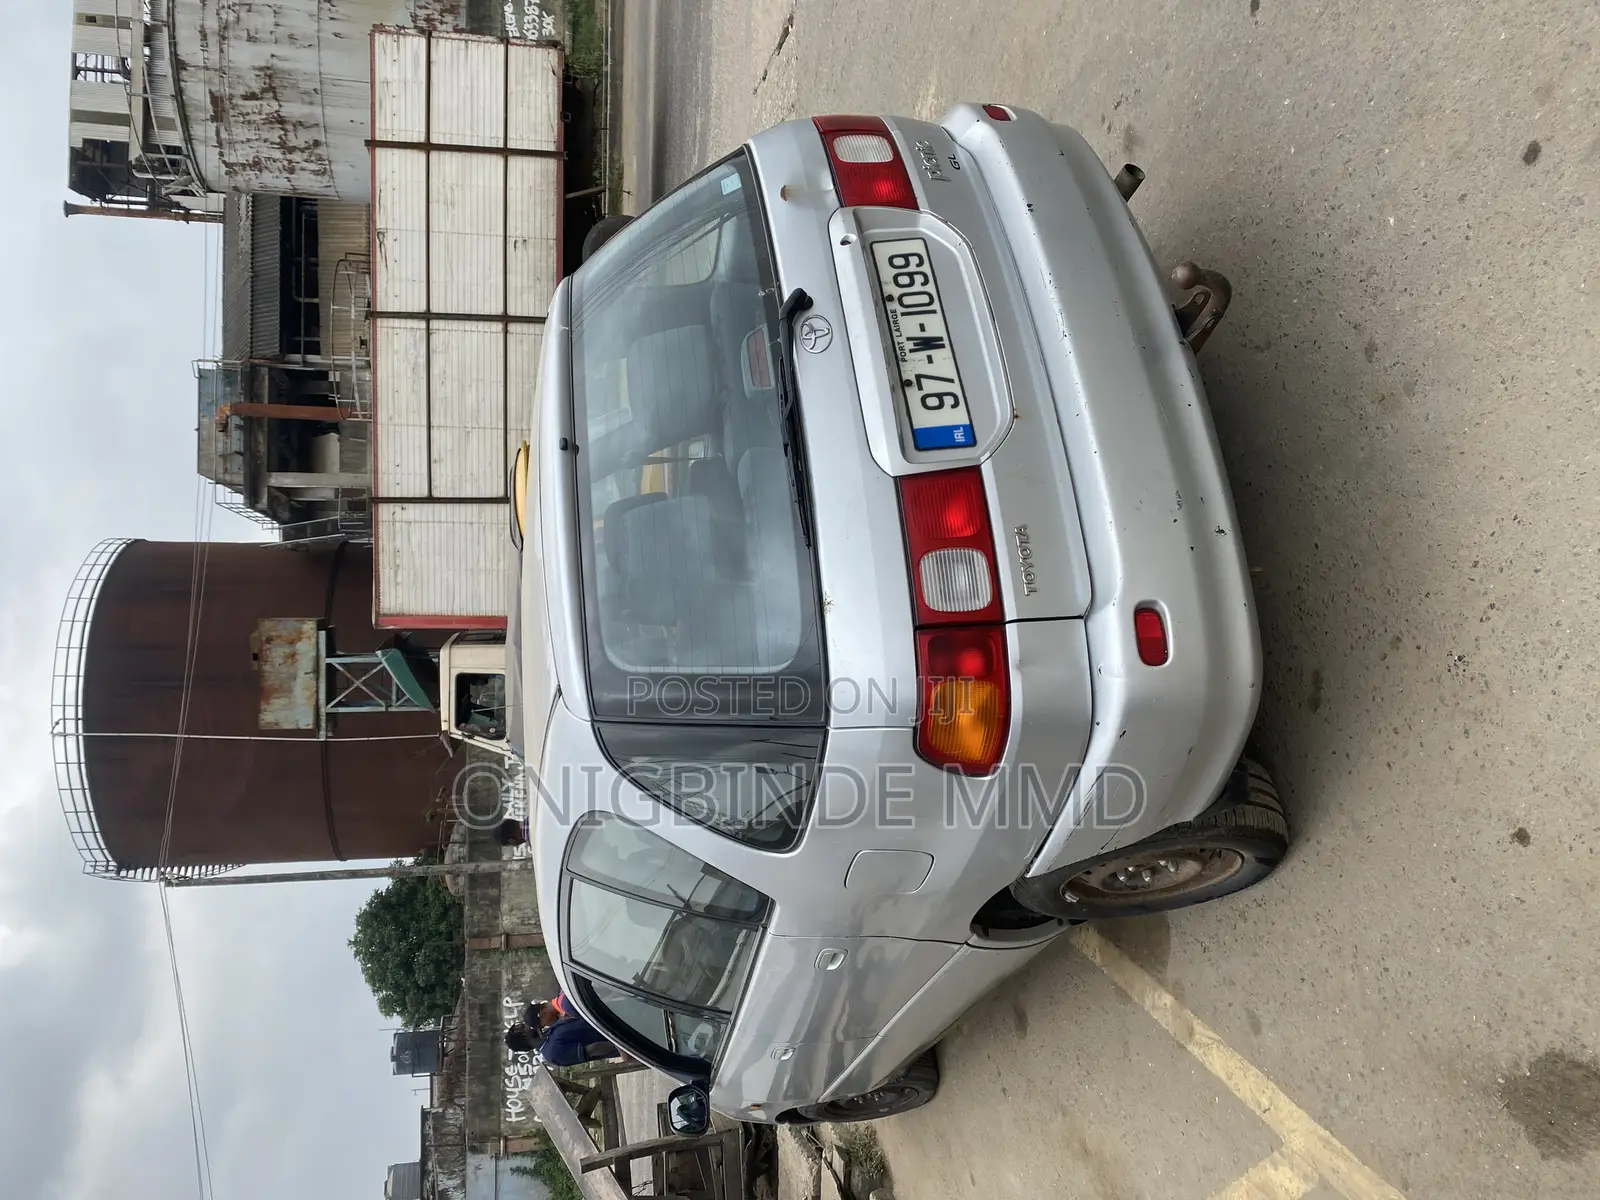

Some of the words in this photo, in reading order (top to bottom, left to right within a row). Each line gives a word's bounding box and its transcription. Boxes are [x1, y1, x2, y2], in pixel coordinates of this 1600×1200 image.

[948, 154, 960, 170] GL
[897, 341, 908, 363] PORT
[953, 426, 966, 442] IRL
[1014, 525, 1037, 596] TOYOTA
[505, 1064, 526, 1123] HOUSE
